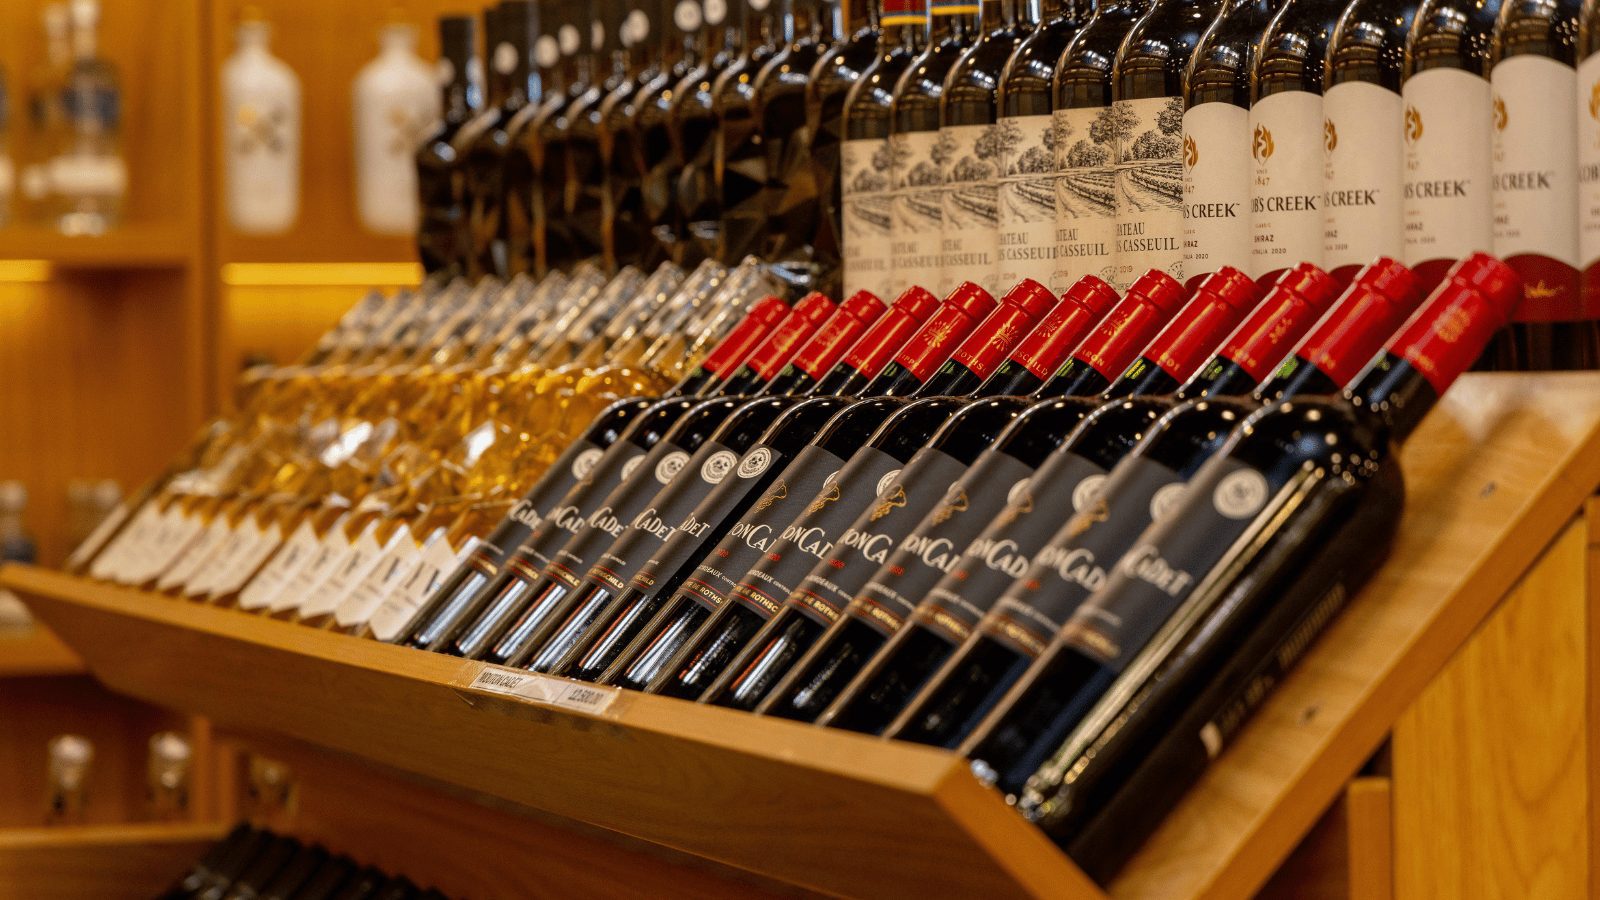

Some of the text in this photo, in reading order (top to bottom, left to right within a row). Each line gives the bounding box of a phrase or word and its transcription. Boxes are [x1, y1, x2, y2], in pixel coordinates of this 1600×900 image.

[1416, 180, 1466, 198] CREEK
[1502, 171, 1550, 191] CREEK
[1267, 196, 1316, 212] CREEK
[1331, 189, 1376, 207] CREEK
[1192, 203, 1236, 218] CREEK
[1123, 237, 1180, 252] CASSEUIL
[1120, 265, 1133, 273] 2019
[590, 506, 629, 537] CADE
[635, 508, 677, 542] CADET
[751, 591, 779, 613] ROTHSC
